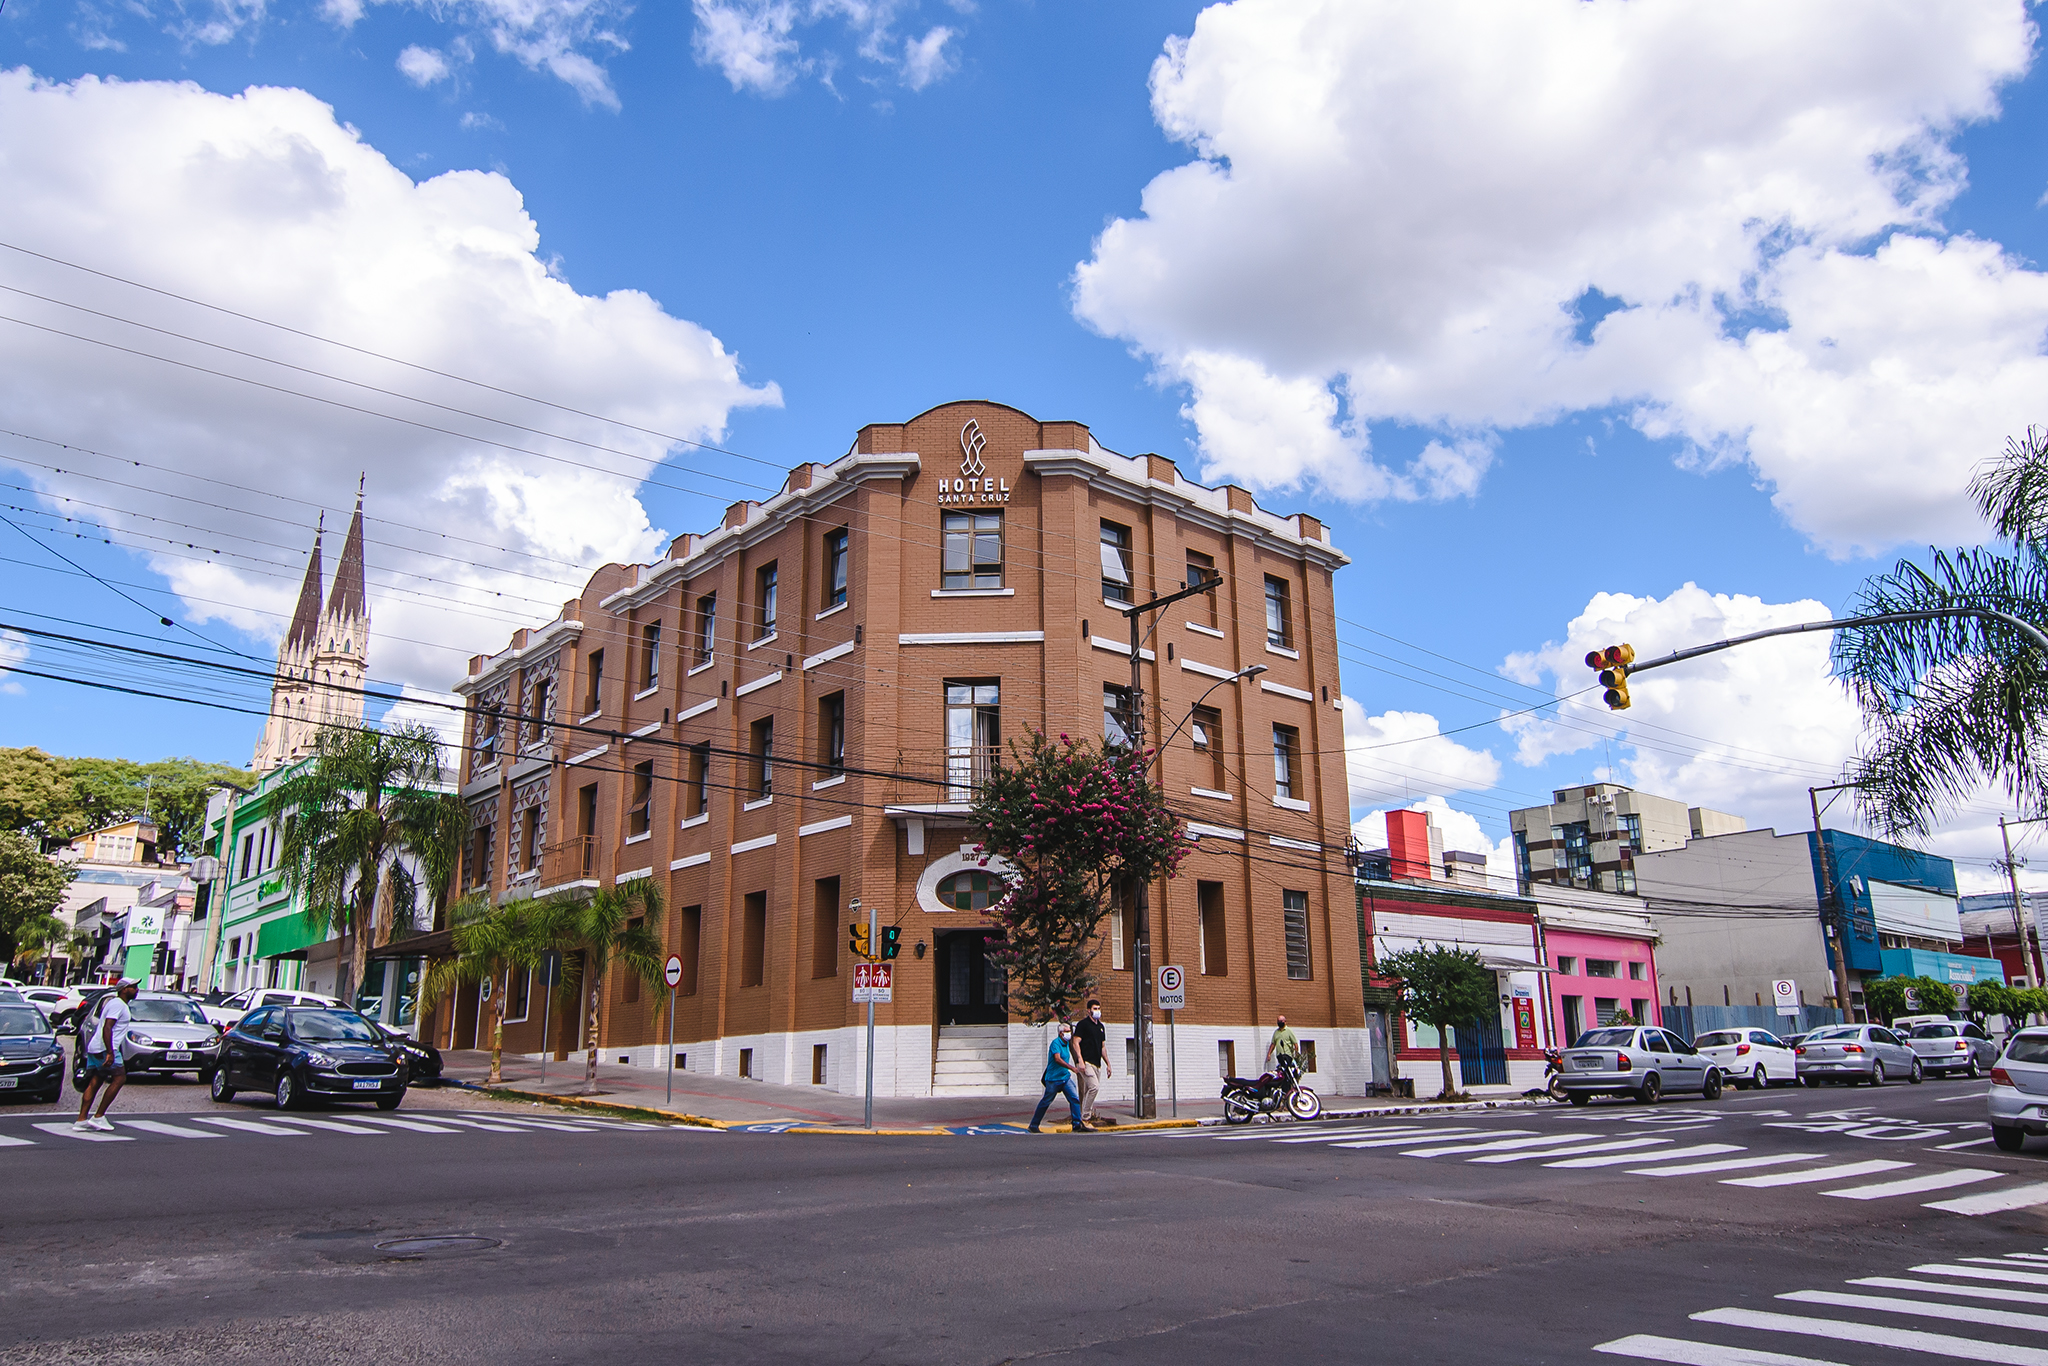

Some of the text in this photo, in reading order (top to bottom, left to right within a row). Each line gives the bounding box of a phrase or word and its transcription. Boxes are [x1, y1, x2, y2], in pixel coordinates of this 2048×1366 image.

[938, 477, 1010, 493] HOTEL
[938, 493, 1010, 503] SANTA CRUZ
[962, 853, 980, 861] 1927
[1167, 972, 1176, 985] E
[1781, 984, 1787, 993] E
[1160, 995, 1183, 1003] MOTOS
[1761, 1121, 1950, 1141] 40
